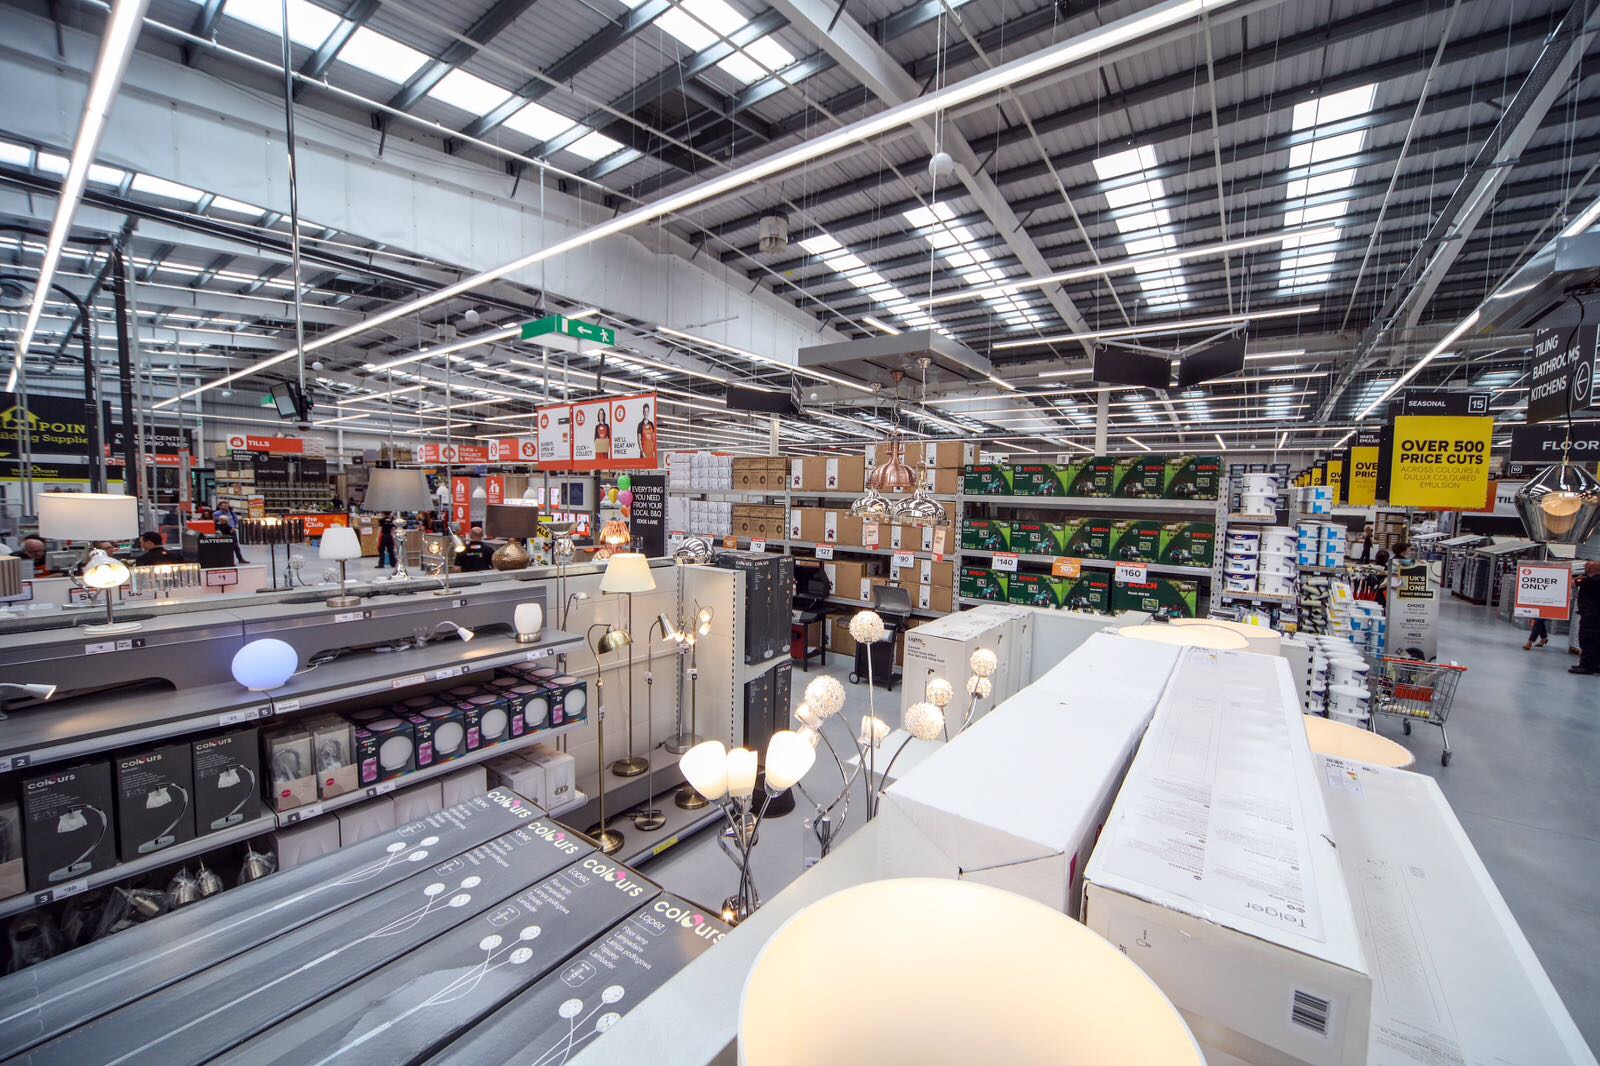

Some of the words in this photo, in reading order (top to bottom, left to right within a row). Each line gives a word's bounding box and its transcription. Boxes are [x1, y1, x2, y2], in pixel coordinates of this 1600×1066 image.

[1535, 334, 1558, 358] TILING
[1530, 375, 1567, 402] KITCHENS
[1472, 400, 1484, 409] 15
[38, 421, 87, 434] POIN
[1401, 440, 1450, 452] OVER
[1454, 440, 1484, 452] 500
[1355, 462, 1379, 470] OVE
[1400, 454, 1443, 464] PRICE
[1446, 454, 1484, 464] CUTS
[537, 526, 549, 538] ALS
[1121, 569, 1141, 577] £160
[196, 736, 232, 750] colours
[121, 752, 162, 769] colours
[27, 773, 76, 790] colours
[487, 790, 532, 820] colours
[515, 830, 532, 842] opez
[528, 822, 579, 855] colours
[568, 868, 591, 884] Lopez
[583, 859, 643, 898] colours
[639, 912, 666, 931] Lopez
[654, 900, 727, 945] colours
[1244, 901, 1308, 928] Teiger
[614, 932, 644, 953] Lampadaire
[622, 925, 635, 936] Floor
[635, 934, 649, 946] lamp
[606, 938, 623, 953] Lampa
[589, 950, 616, 970] Lambader
